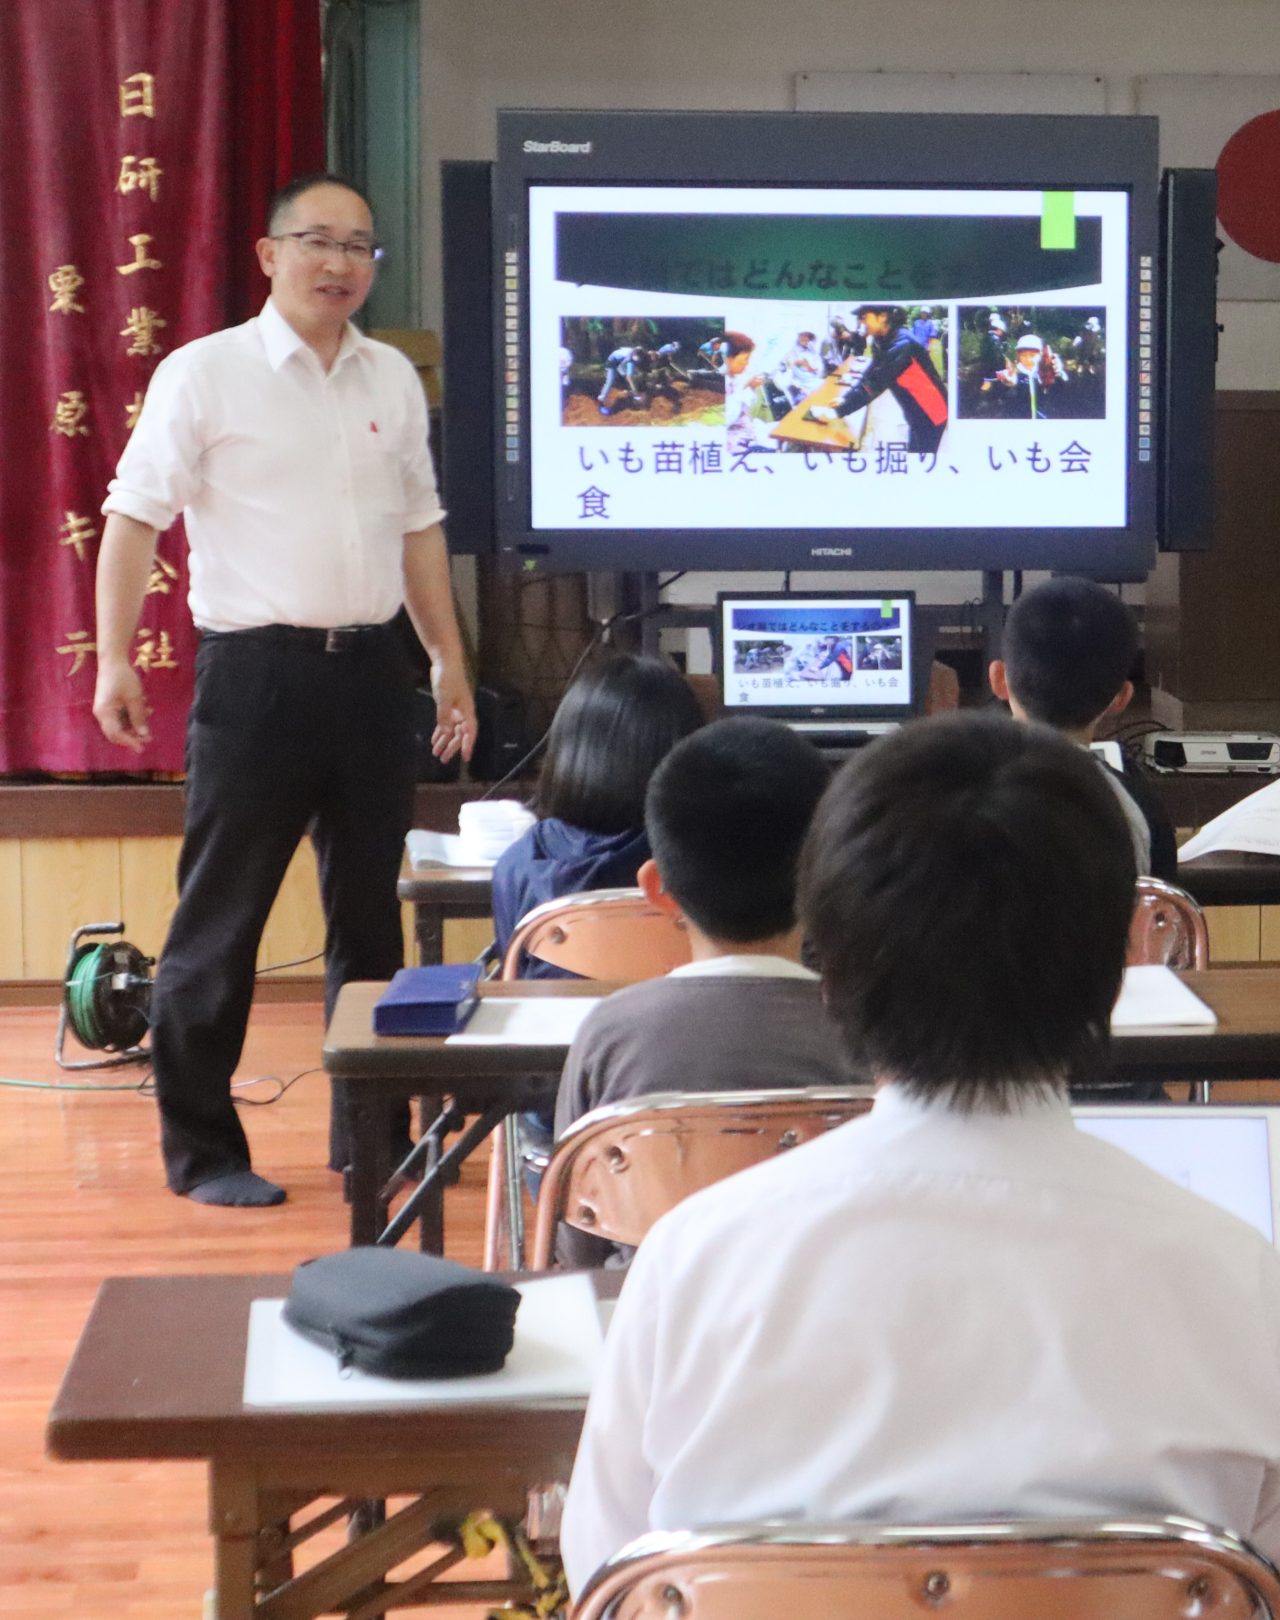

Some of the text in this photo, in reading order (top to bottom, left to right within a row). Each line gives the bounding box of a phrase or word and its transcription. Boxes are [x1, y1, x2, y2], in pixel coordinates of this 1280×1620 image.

[523, 140, 592, 153] StarBoard
[115, 72, 178, 671] 日研工業会社
[577, 485, 611, 519] 食
[811, 547, 852, 556] HITACHI
